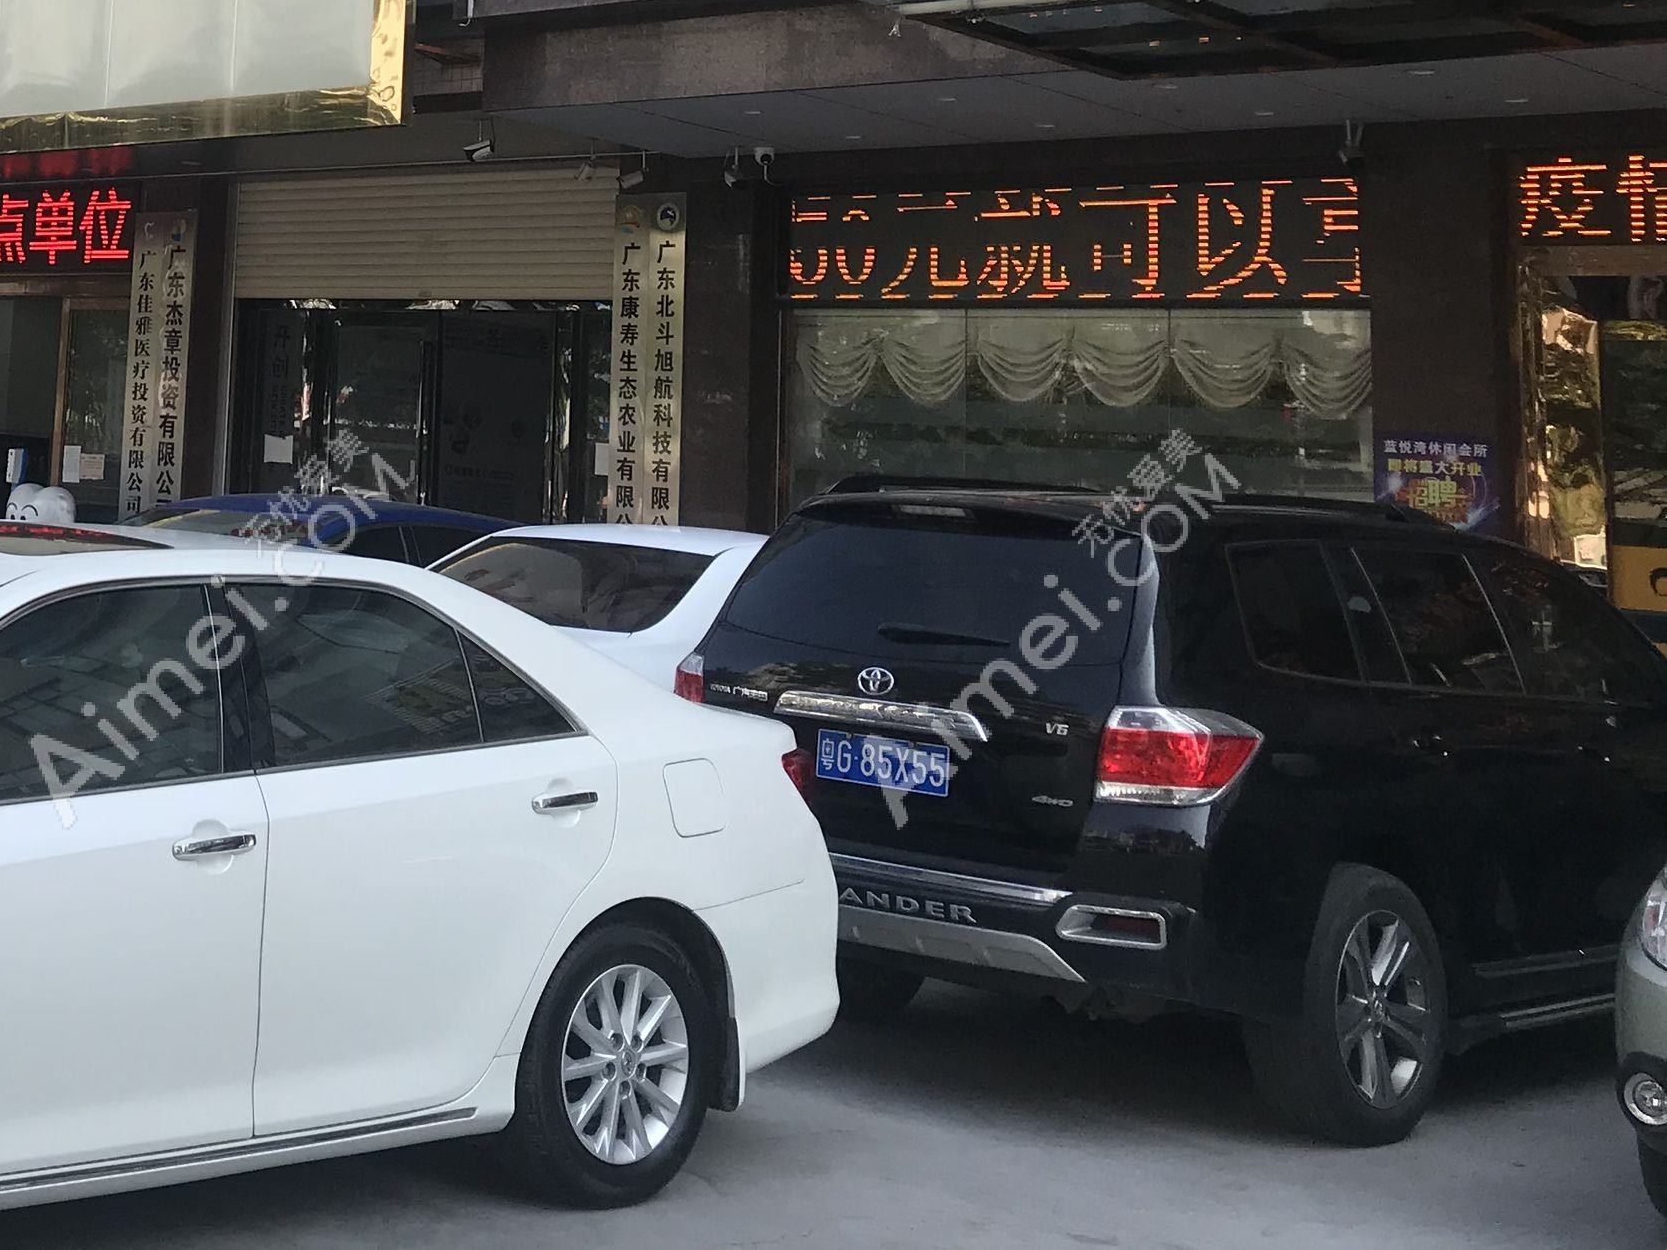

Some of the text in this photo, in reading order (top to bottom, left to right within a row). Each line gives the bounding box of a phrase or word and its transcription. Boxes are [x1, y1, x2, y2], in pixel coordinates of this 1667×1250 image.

[125, 250, 157, 514] 广东佳雅医疗投资有限公司
[155, 246, 187, 507] 广东杰章投资有限公
[1384, 440, 1488, 458] 蓝悦湾休闲会所
[1387, 458, 1482, 476] 即将盛大开业
[1407, 476, 1457, 509] 招聘
[1045, 721, 1070, 736] V6
[1031, 794, 1074, 808] 4WD
[839, 887, 977, 924] ANDER
